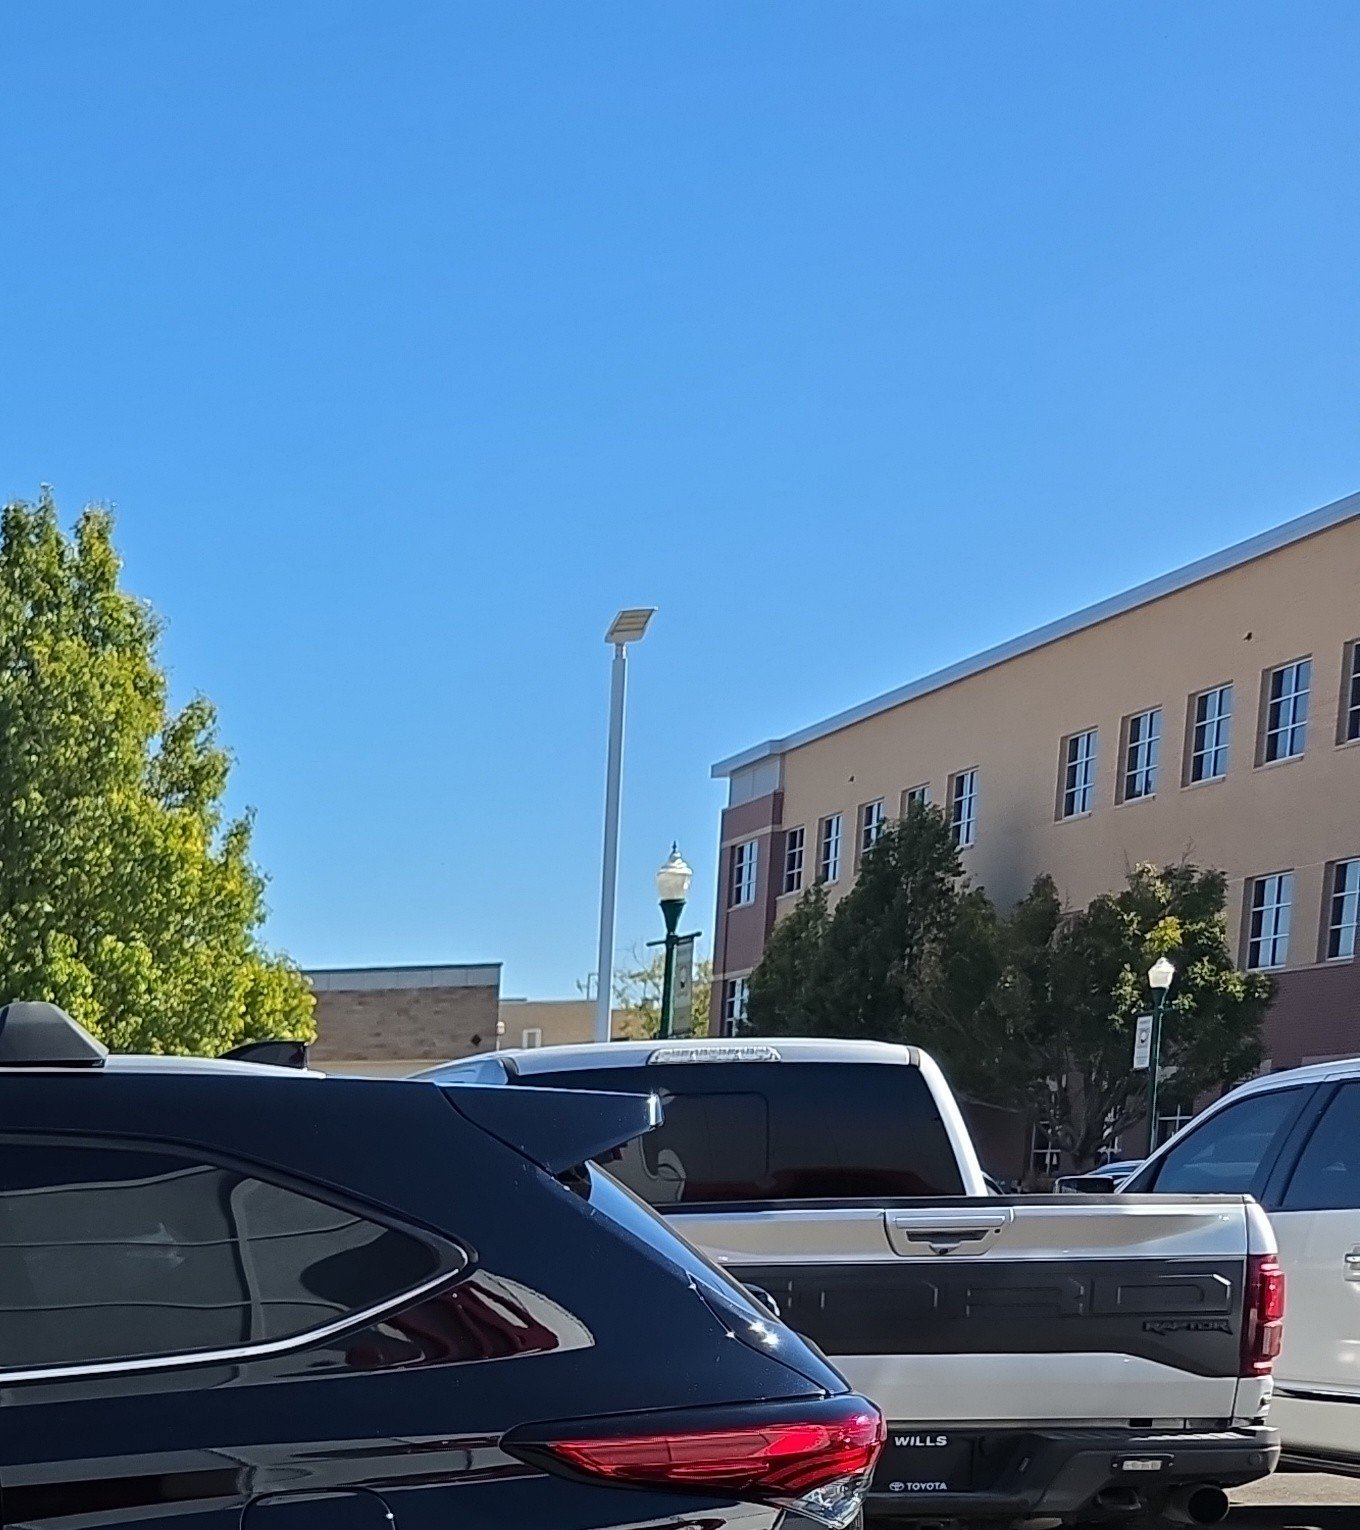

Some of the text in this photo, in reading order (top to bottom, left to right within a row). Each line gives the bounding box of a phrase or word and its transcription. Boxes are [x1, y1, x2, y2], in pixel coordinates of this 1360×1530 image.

[750, 1273, 1233, 1318] ORD
[1142, 1319, 1233, 1335] RAPTOR
[894, 1435, 948, 1446] WILLS
[905, 1481, 948, 1491] TOYOTA
